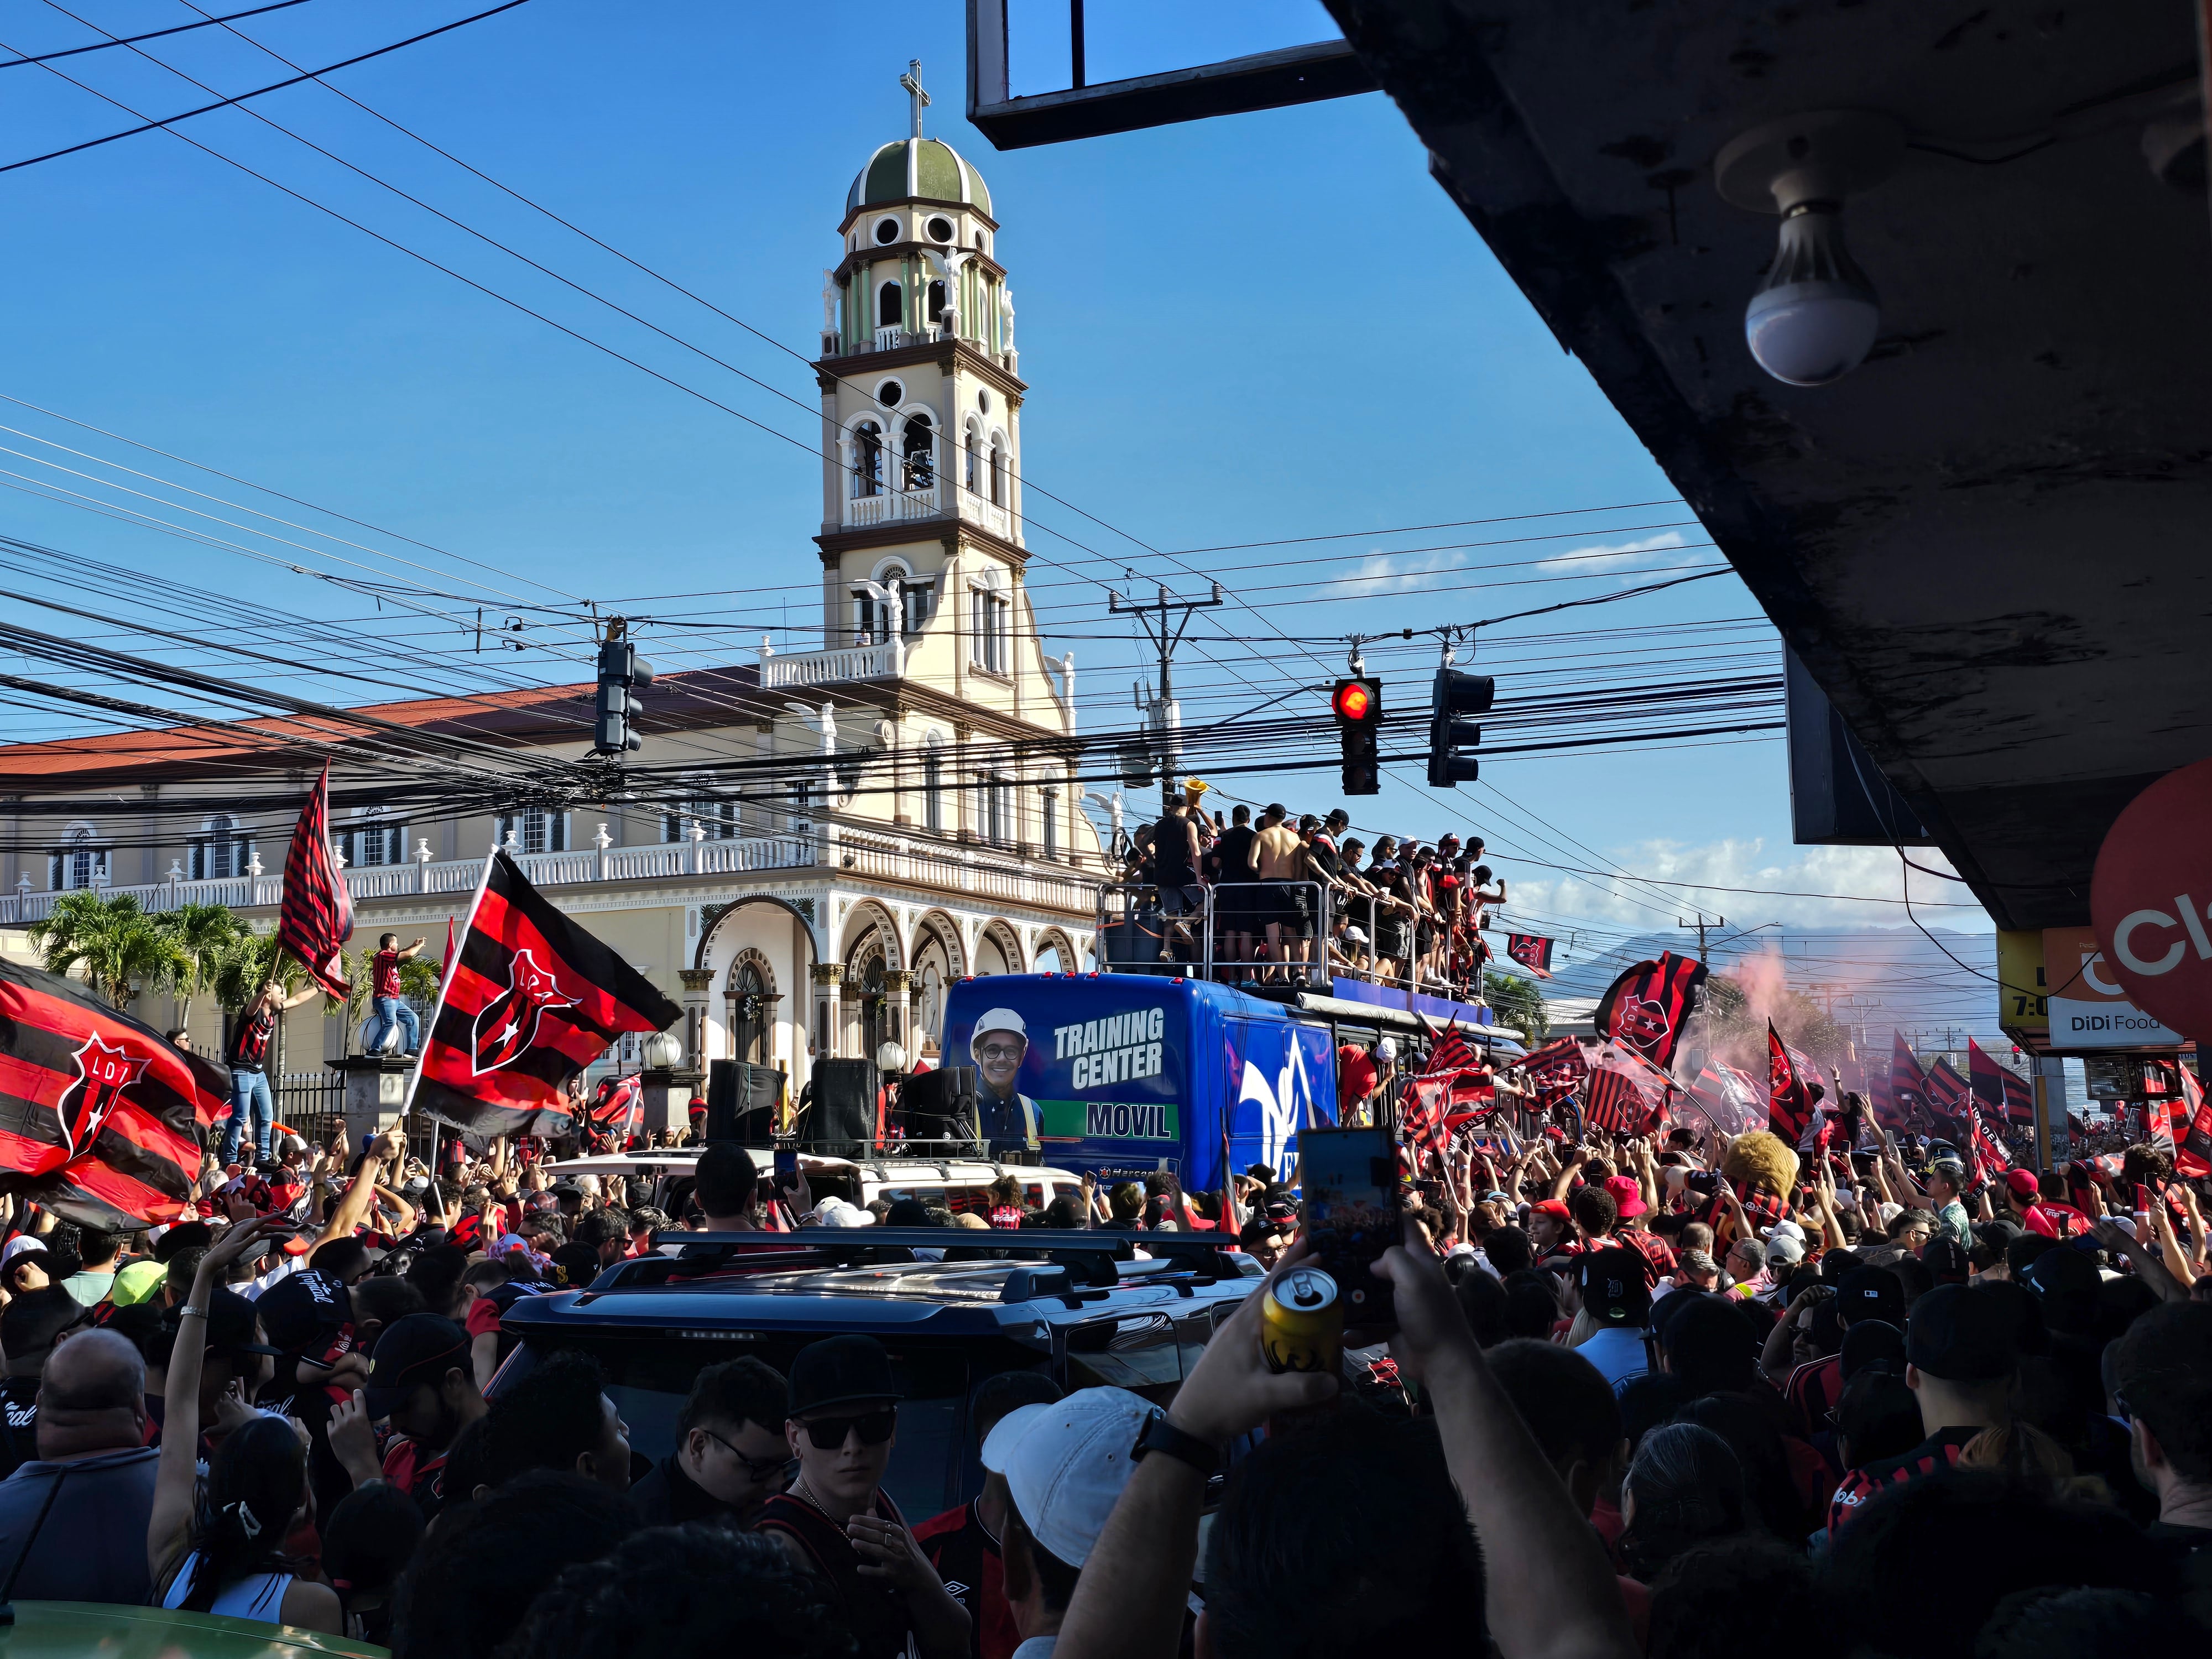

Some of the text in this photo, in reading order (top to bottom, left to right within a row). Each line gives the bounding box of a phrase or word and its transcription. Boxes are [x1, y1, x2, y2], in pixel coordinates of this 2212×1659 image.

[2114, 894, 2212, 976] cl
[1055, 1007, 1164, 1060] TRAINING
[1625, 1005, 1639, 1031] LDA
[2071, 1015, 2110, 1031] DiDi
[1072, 1042, 1162, 1090] CENTER
[1086, 1103, 1171, 1139] MOVIL
